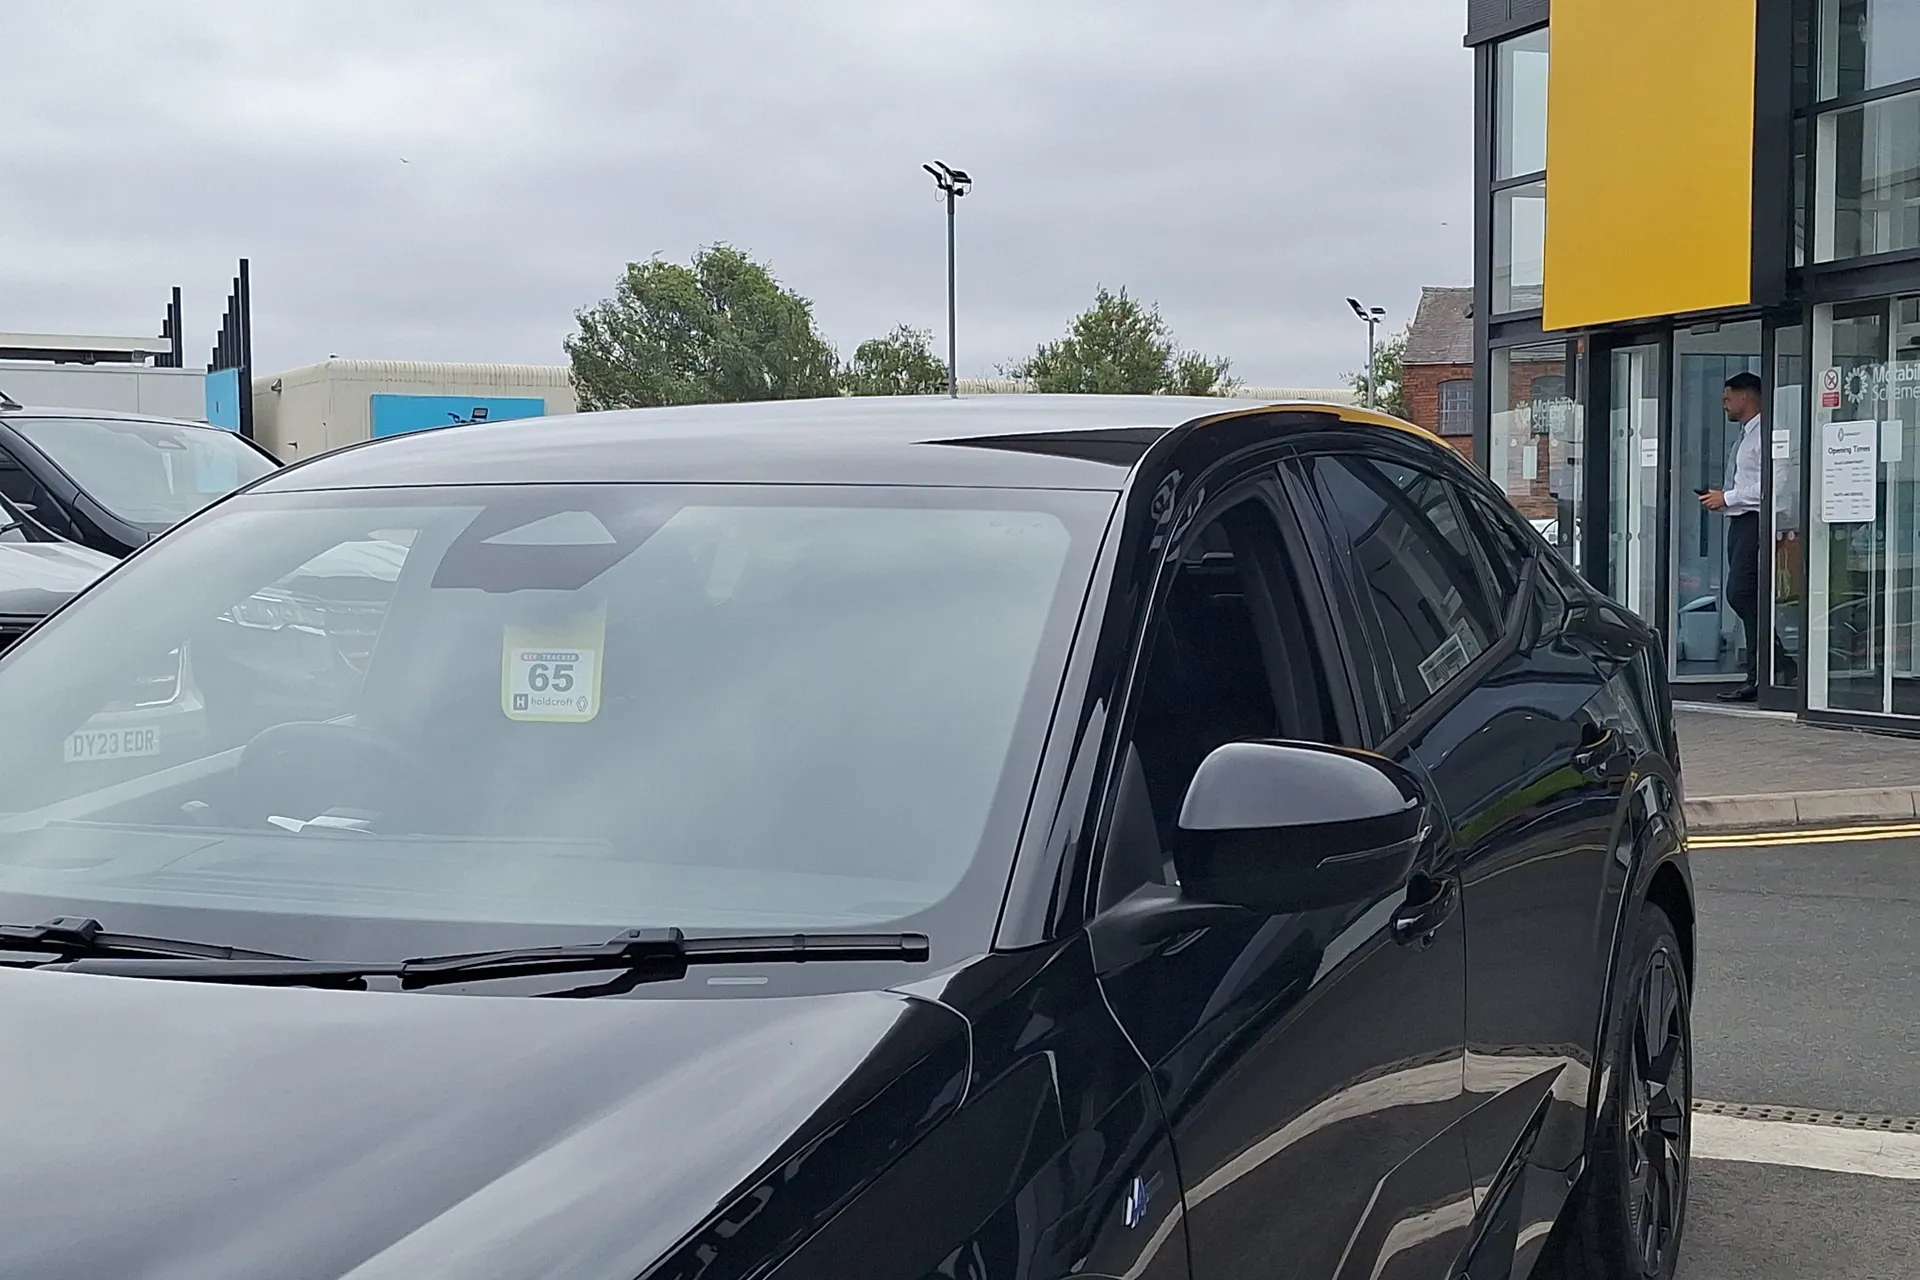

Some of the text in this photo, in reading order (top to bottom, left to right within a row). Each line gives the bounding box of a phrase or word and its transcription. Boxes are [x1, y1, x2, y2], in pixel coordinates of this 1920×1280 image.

[1828, 445, 1871, 455] Opening Times
[527, 663, 574, 692] 65
[530, 696, 573, 706] holdcroft
[124, 729, 155, 752] EDR
